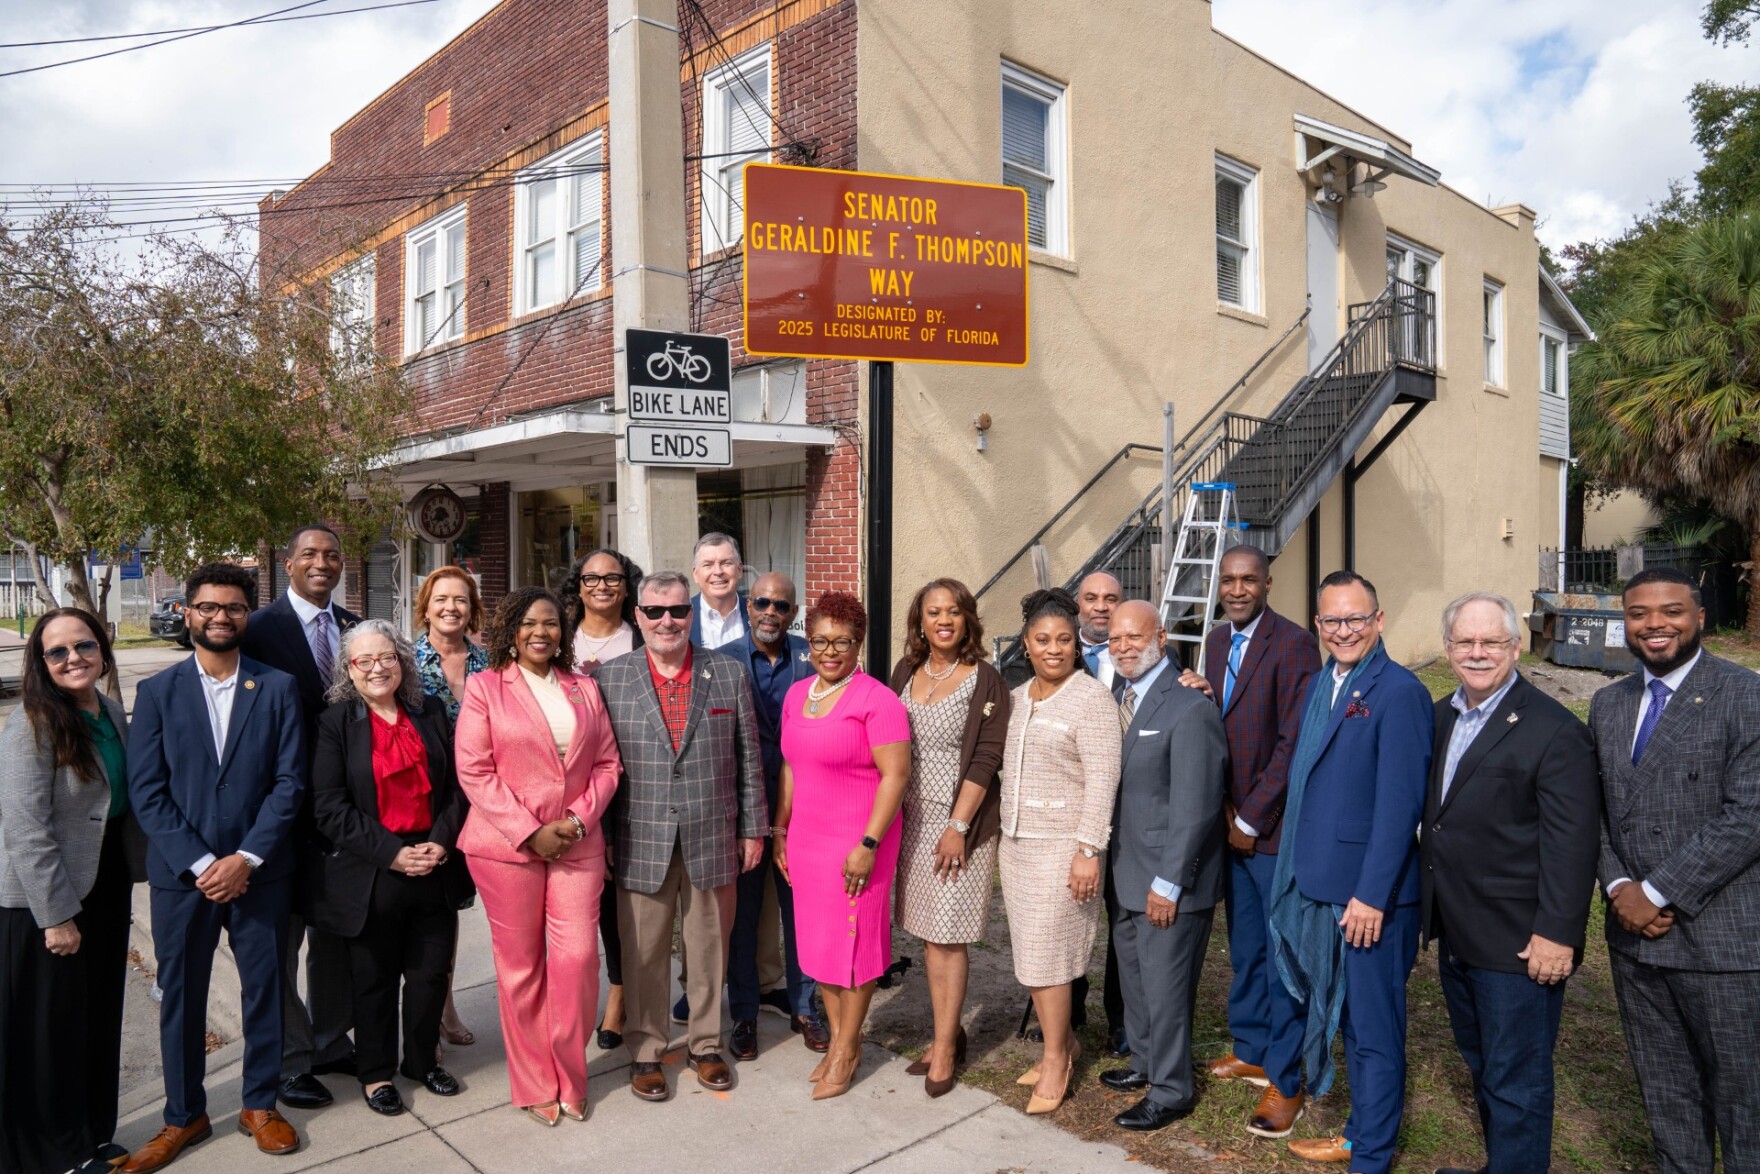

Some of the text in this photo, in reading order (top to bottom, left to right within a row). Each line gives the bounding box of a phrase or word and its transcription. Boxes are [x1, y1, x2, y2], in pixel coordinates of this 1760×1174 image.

[844, 191, 937, 225] SENATOR
[751, 221, 1022, 269] GERALDINE F. THOMPSON
[869, 268, 914, 297] WAY
[837, 304, 946, 325] DESIGNATED BY:
[778, 320, 999, 346] 2025 LEGISLATURE OF FLORIDA
[632, 391, 727, 417] BIKE LANE
[651, 433, 709, 458] ENDS
